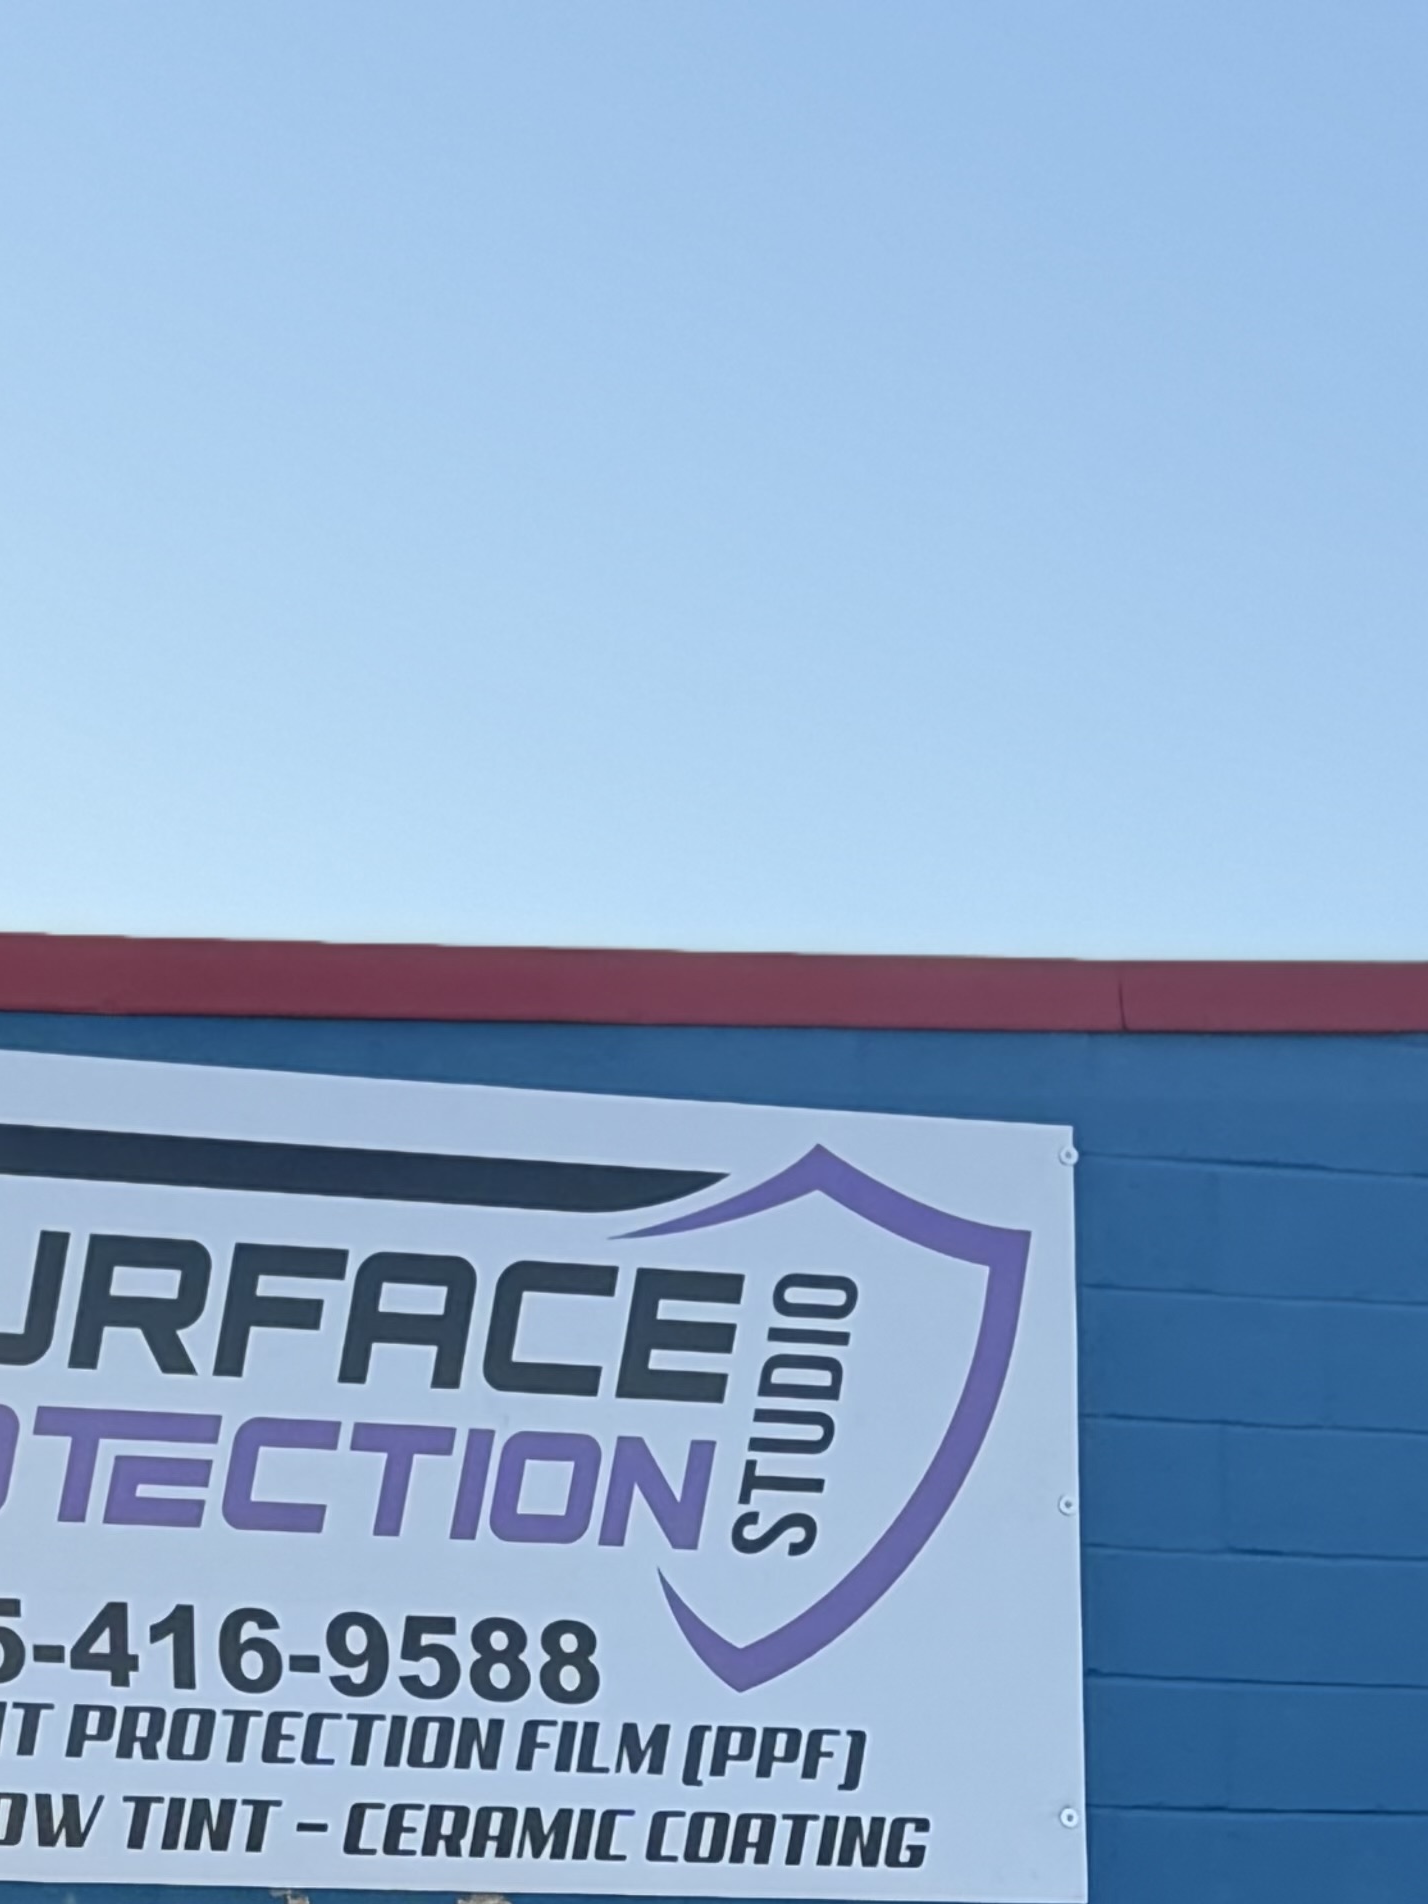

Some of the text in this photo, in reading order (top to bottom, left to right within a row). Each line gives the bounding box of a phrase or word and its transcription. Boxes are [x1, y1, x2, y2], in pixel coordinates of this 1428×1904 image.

[731, 1272, 859, 1557] STUDIO
[65, 1704, 504, 1771] PROTECTION
[515, 1719, 671, 1776] FILM
[122, 1795, 283, 1853] TINT
[342, 1802, 636, 1862] CERAMIC
[645, 1810, 931, 1869] COATING
